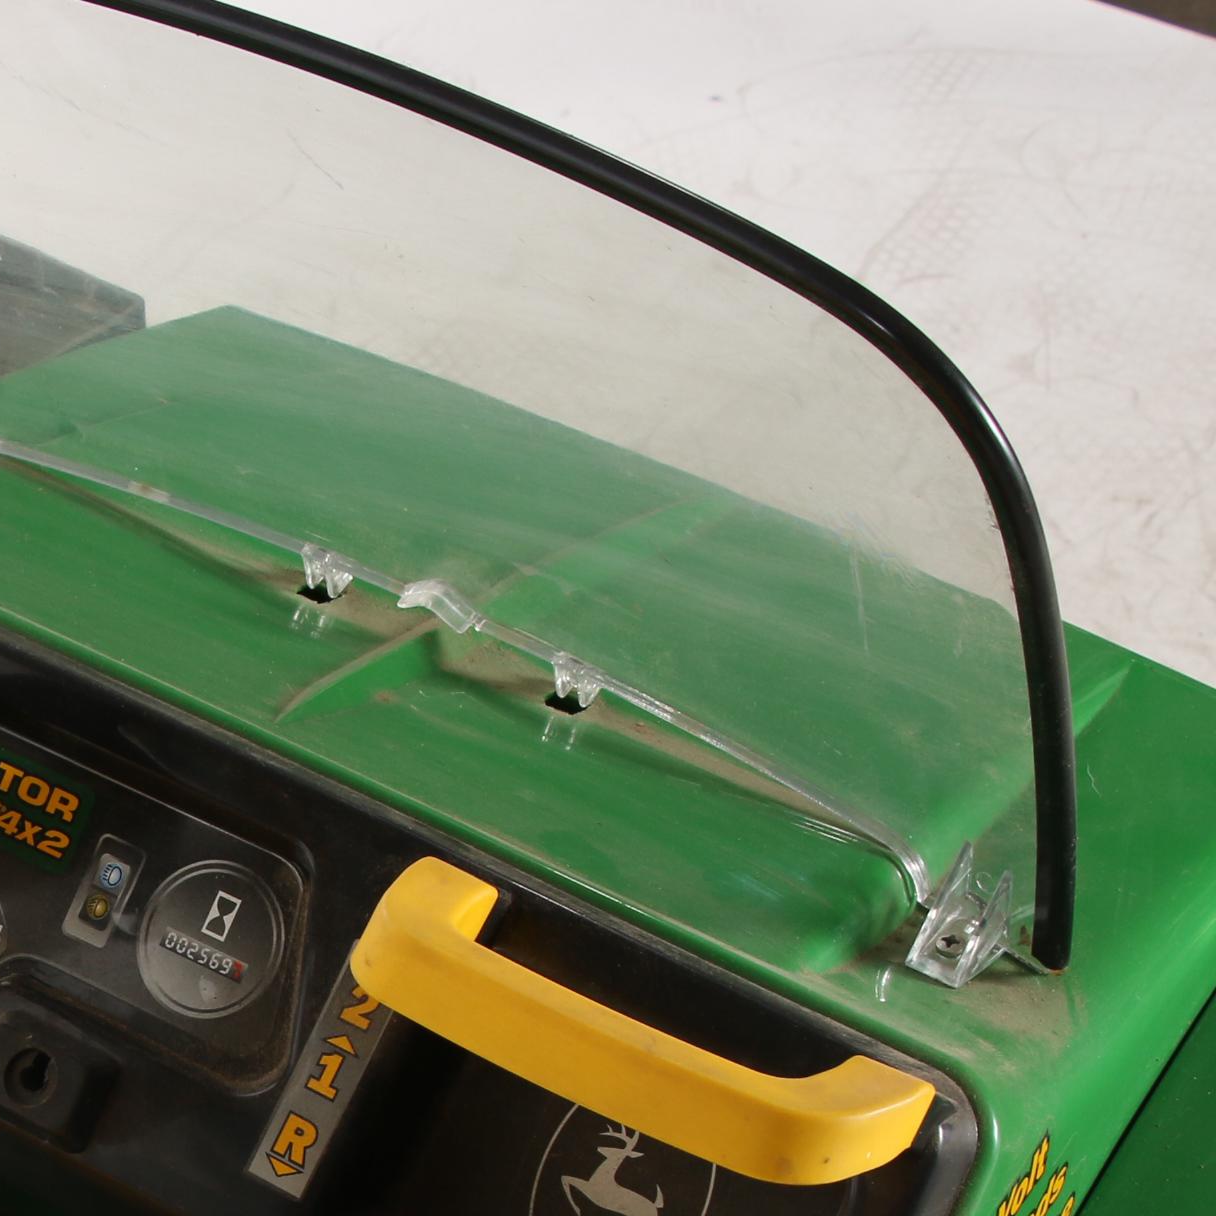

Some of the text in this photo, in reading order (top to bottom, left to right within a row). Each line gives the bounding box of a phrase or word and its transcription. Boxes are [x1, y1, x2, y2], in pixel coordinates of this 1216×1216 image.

[339, 984, 381, 1031] 2
[306, 1053, 345, 1100] 1
[272, 1112, 319, 1166] R
